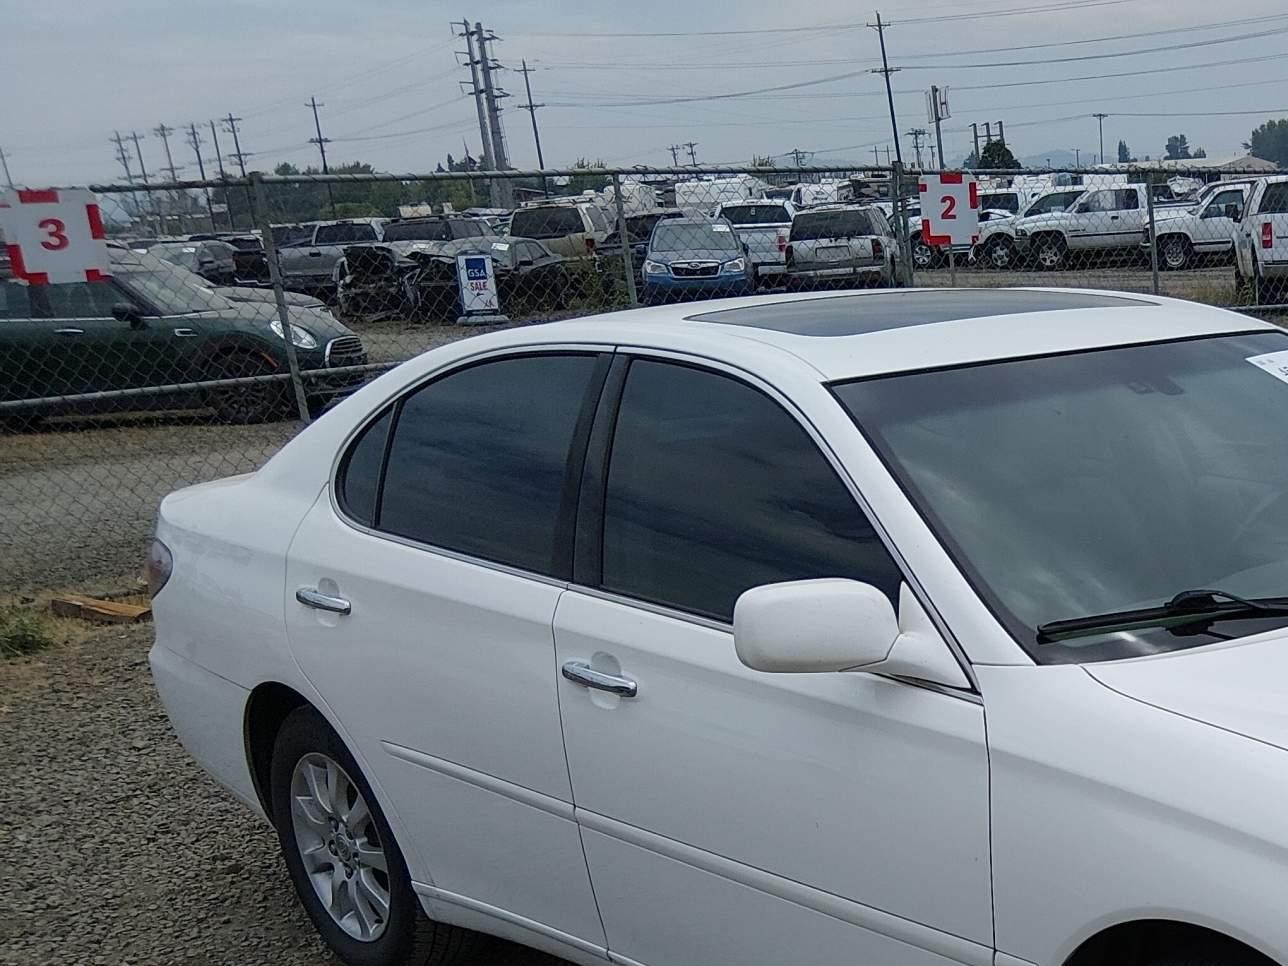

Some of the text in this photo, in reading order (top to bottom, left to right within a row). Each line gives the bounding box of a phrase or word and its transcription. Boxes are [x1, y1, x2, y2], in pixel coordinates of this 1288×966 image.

[940, 195, 957, 220] 2
[38, 218, 70, 251] 3
[467, 268, 487, 278] GSA
[470, 281, 489, 292] SALE
